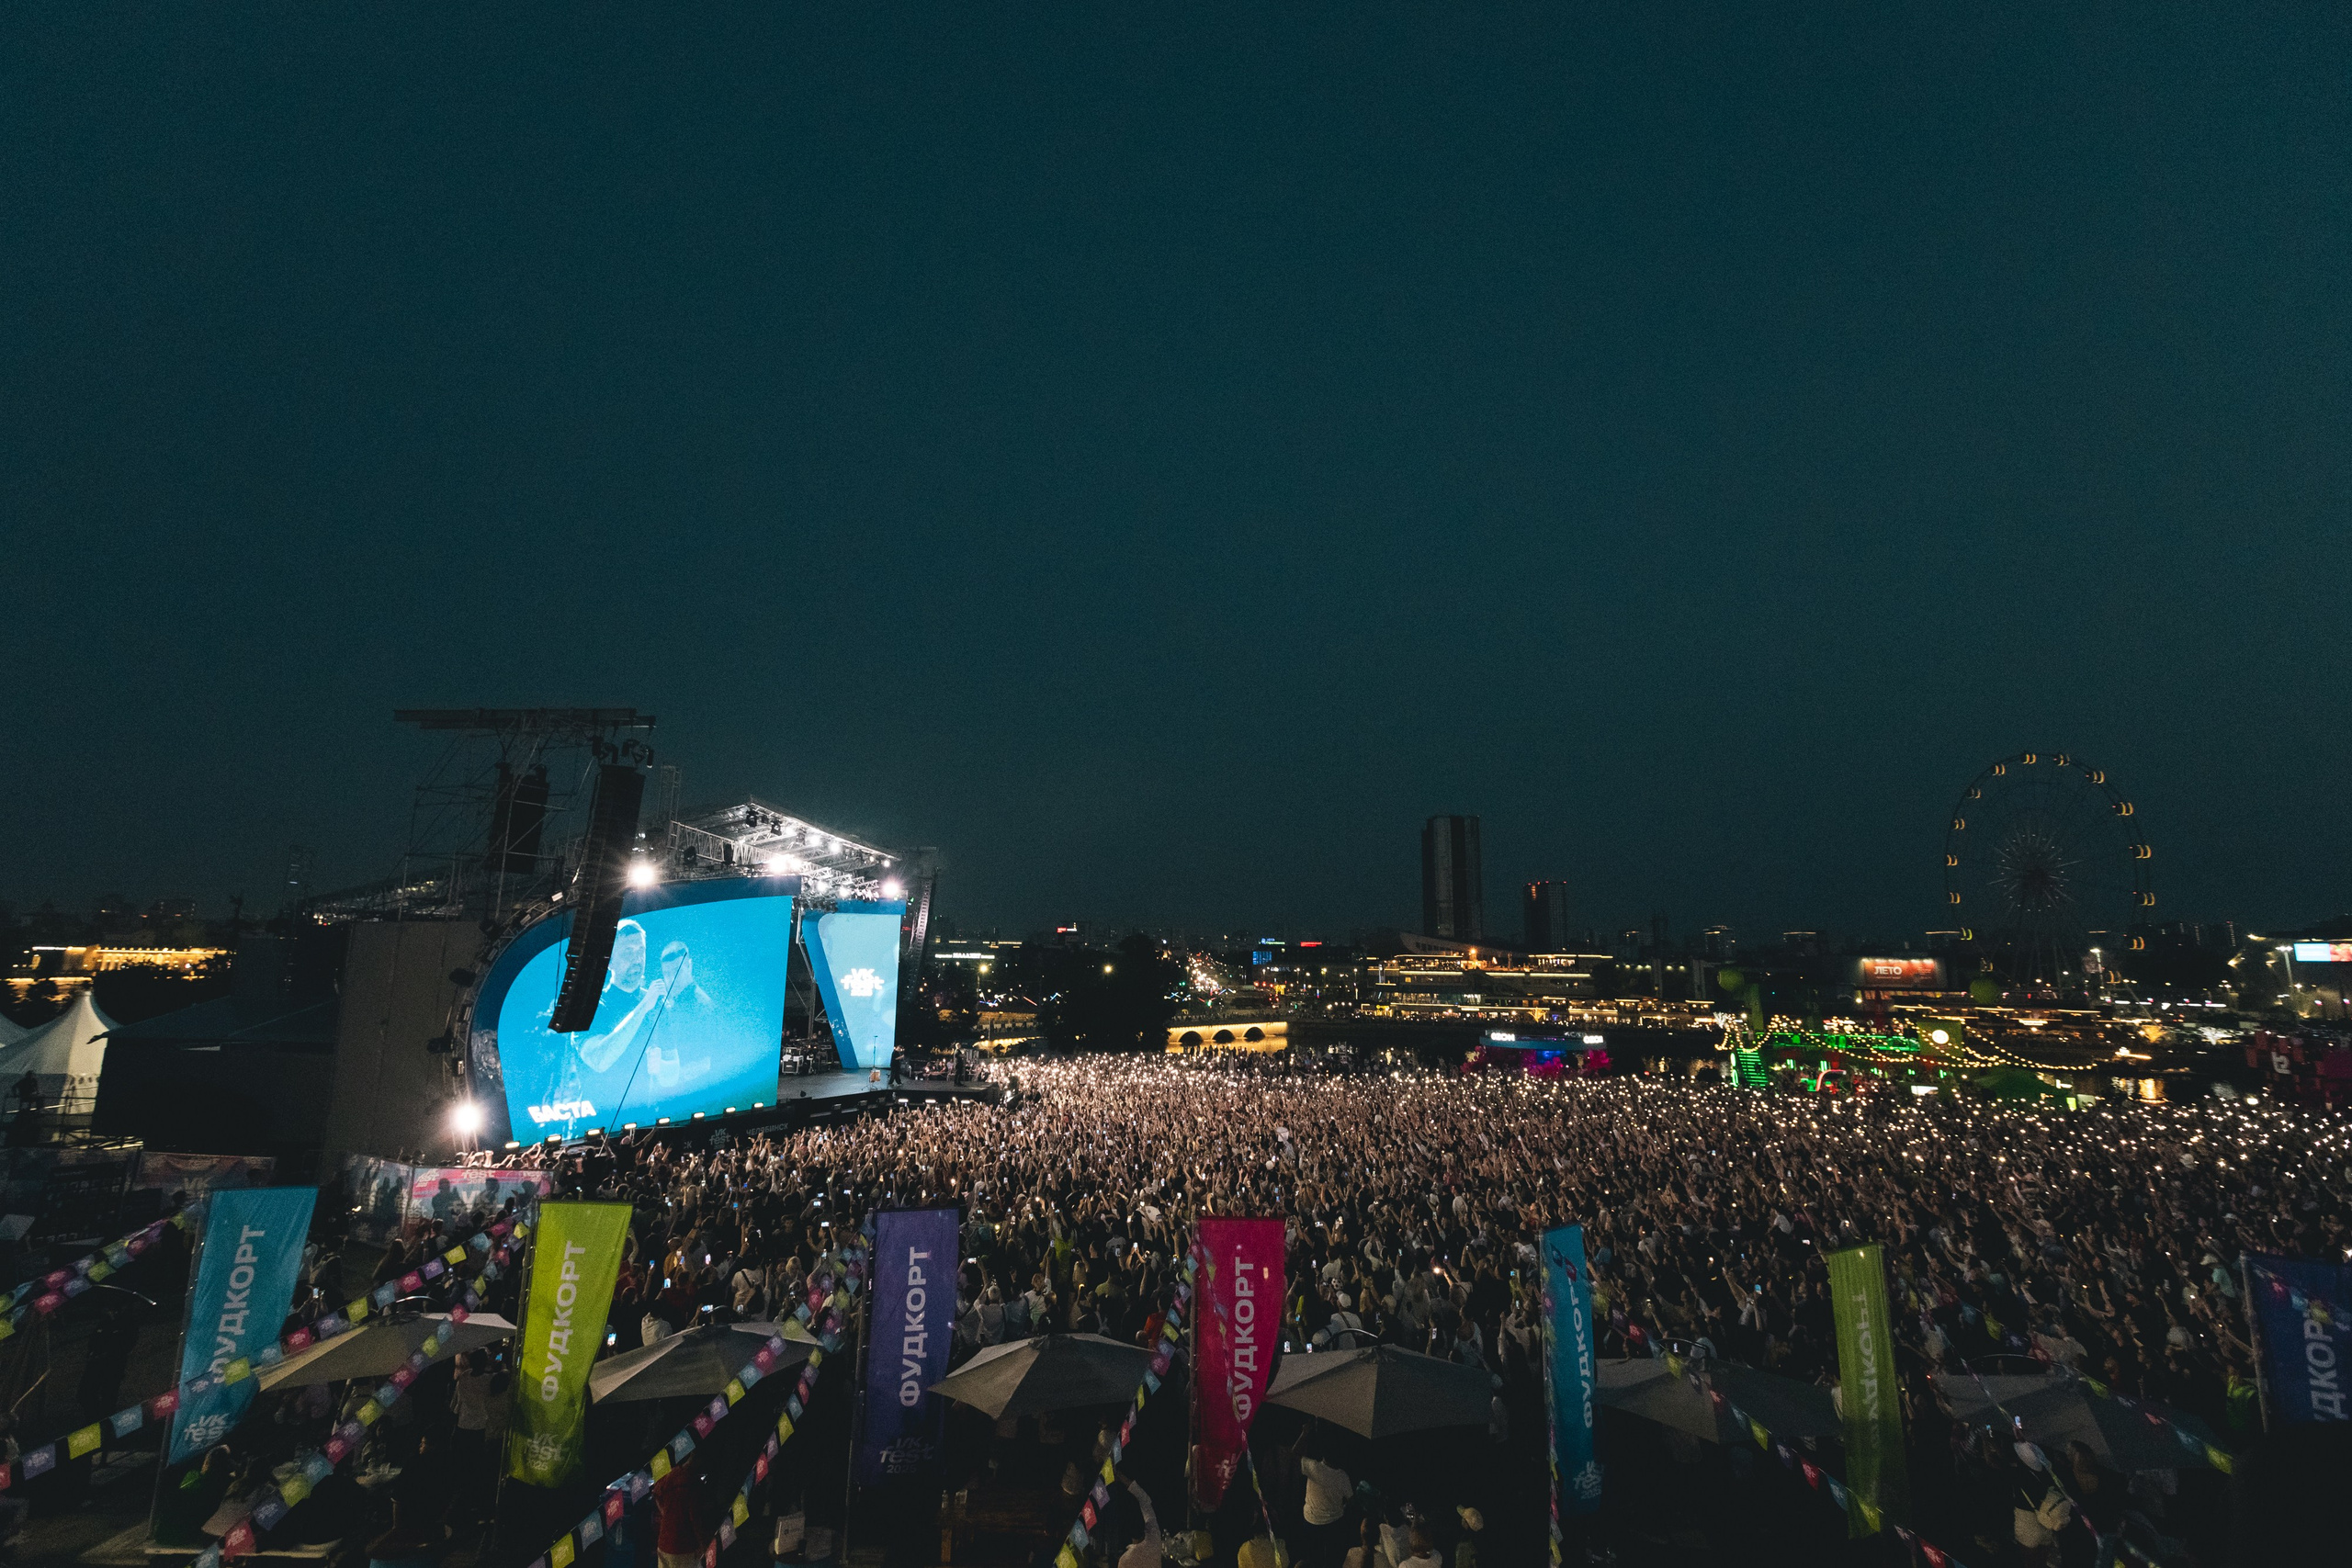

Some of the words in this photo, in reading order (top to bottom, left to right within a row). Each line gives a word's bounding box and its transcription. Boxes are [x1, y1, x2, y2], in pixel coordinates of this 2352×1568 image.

[1874, 966, 1902, 975] ЛЕТО
[527, 1100, 597, 1122] БАСТА
[714, 1128, 728, 1136] VK
[746, 1122, 788, 1136] ЧЕЛЯБИНСК
[709, 1134, 731, 1145] fest
[541, 1240, 586, 1402] ФУДКОРТ
[899, 1247, 929, 1407] ФУДКОРТ
[1234, 1256, 1258, 1423] ФУДКОРТ
[1567, 1278, 1593, 1429] ФУДКОР
[198, 1413, 229, 1427] VK
[532, 1432, 558, 1446] VK
[896, 1436, 923, 1450] VK
[879, 1443, 935, 1464] fest
